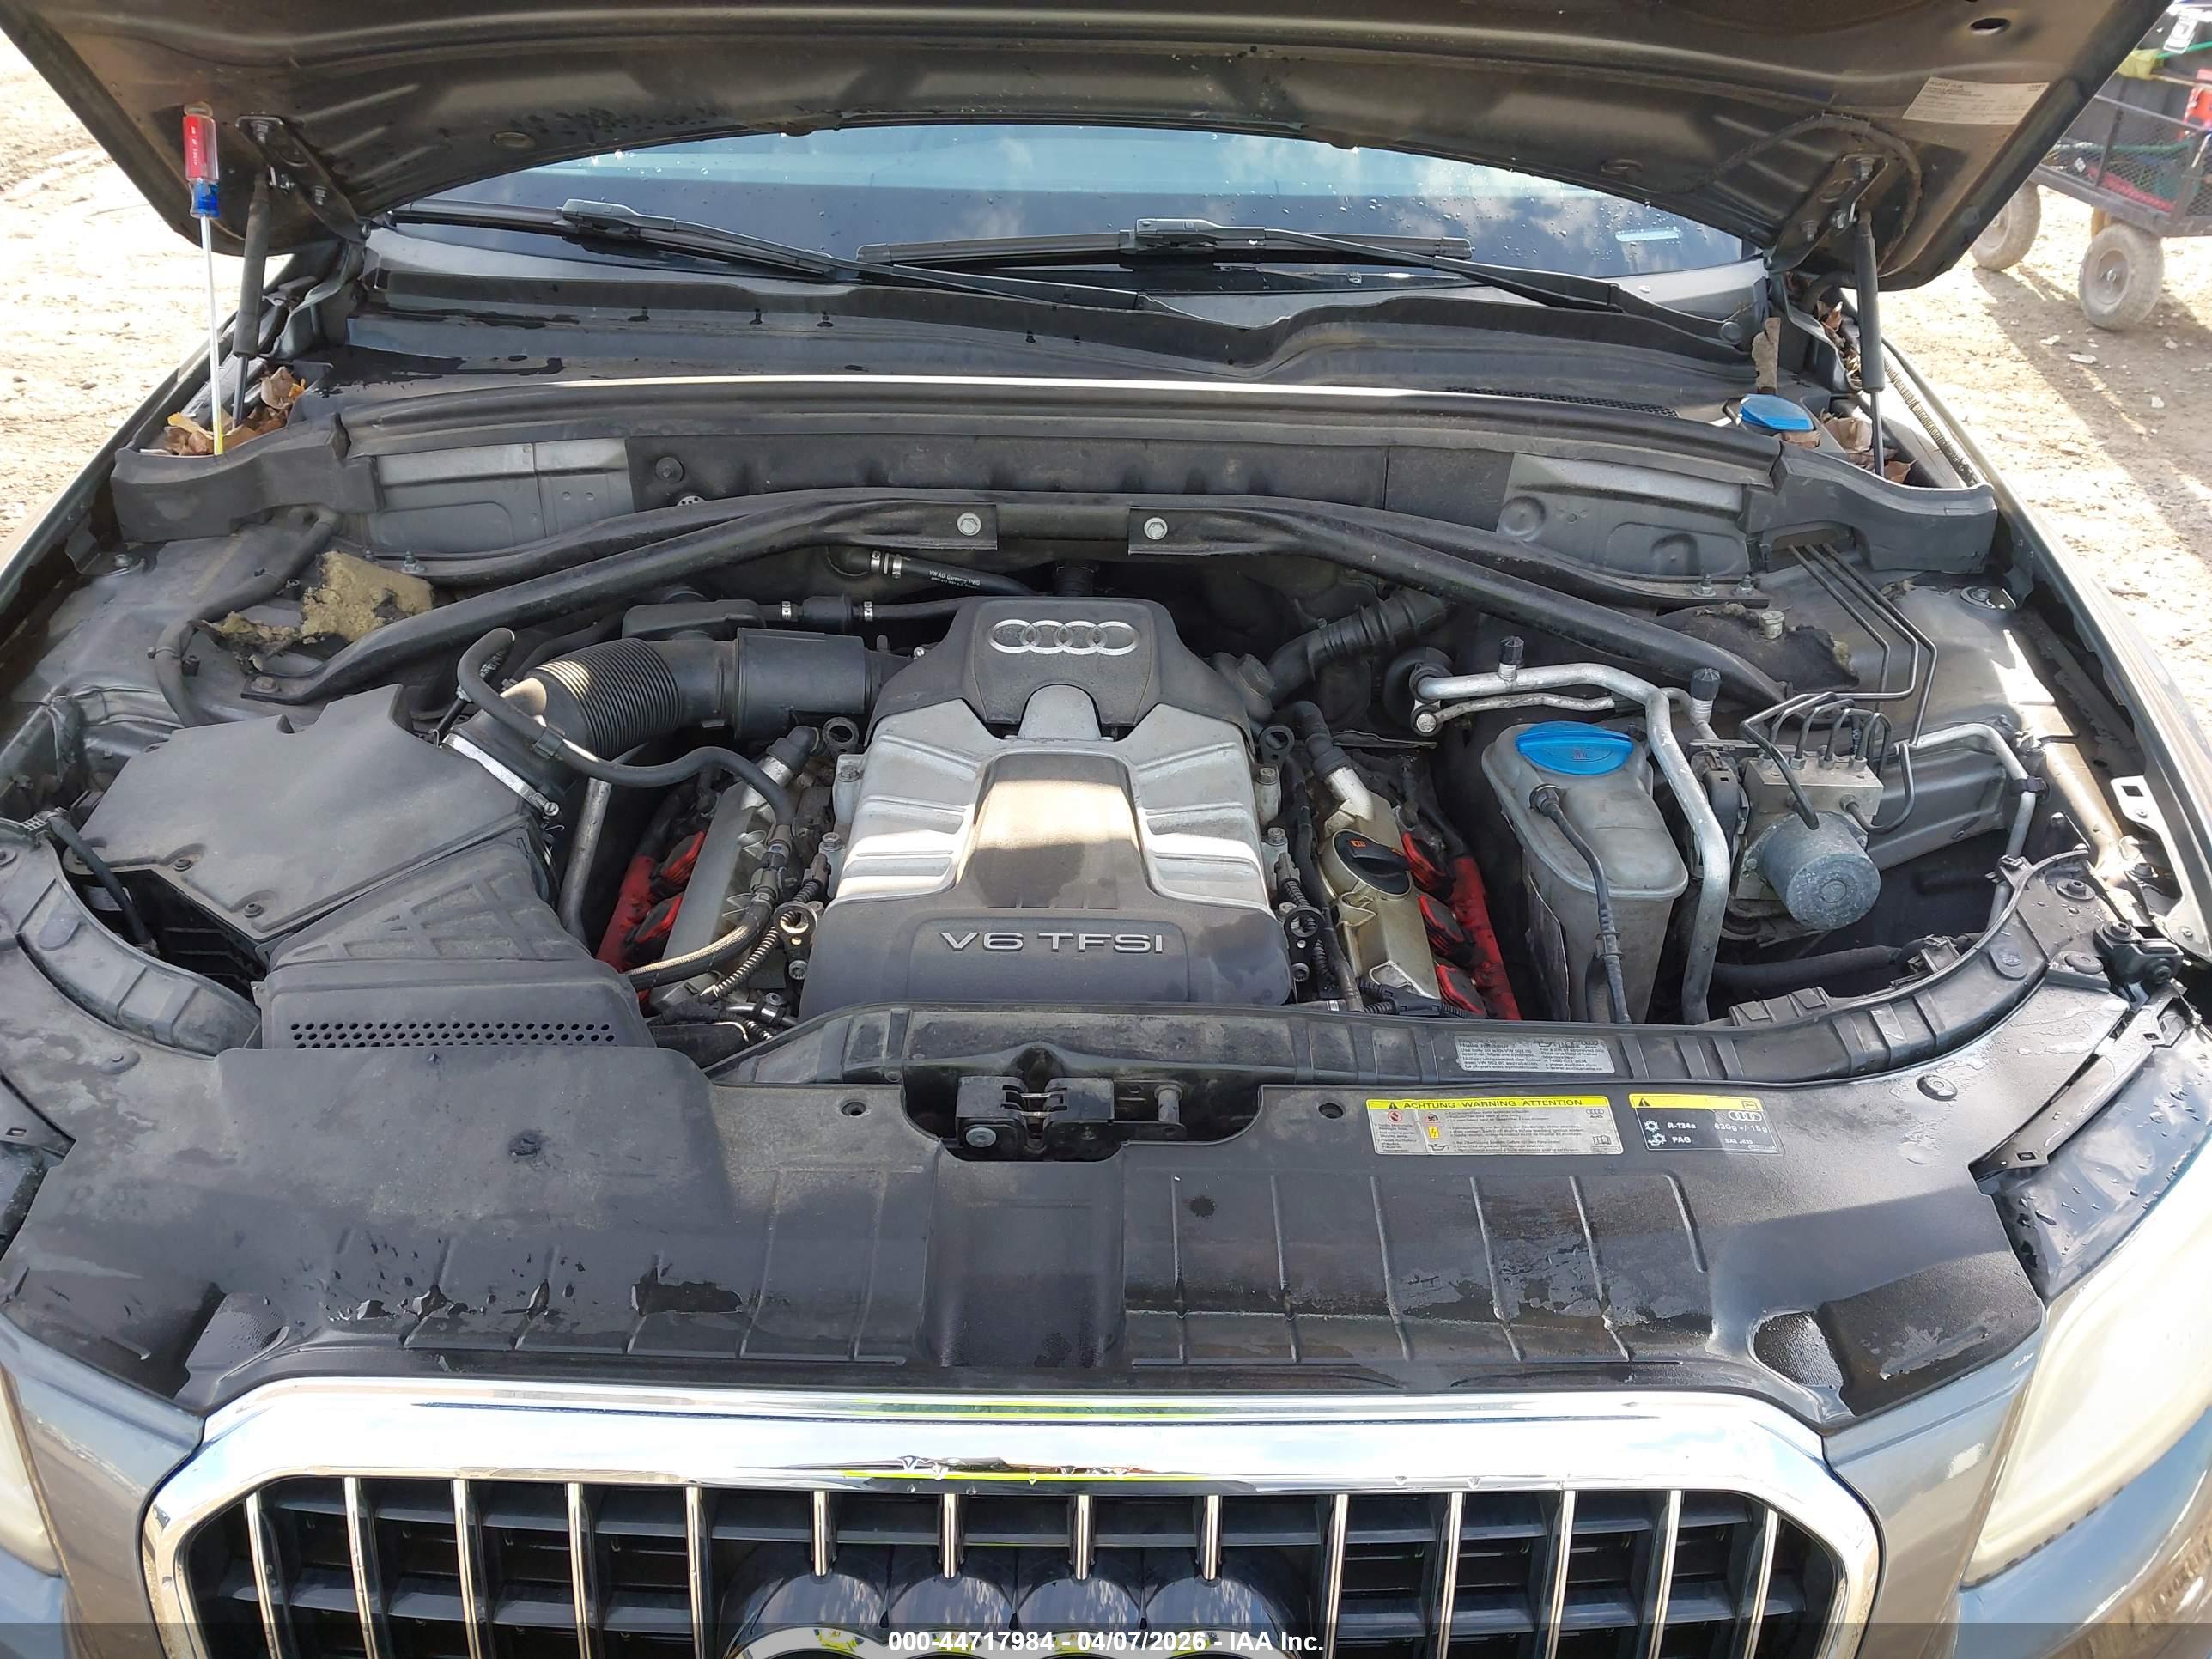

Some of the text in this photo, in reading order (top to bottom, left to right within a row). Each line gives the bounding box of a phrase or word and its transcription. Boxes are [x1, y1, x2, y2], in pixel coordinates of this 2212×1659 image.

[940, 932, 1163, 954] V6 TFSI
[1714, 1123, 1737, 1132] 630g
